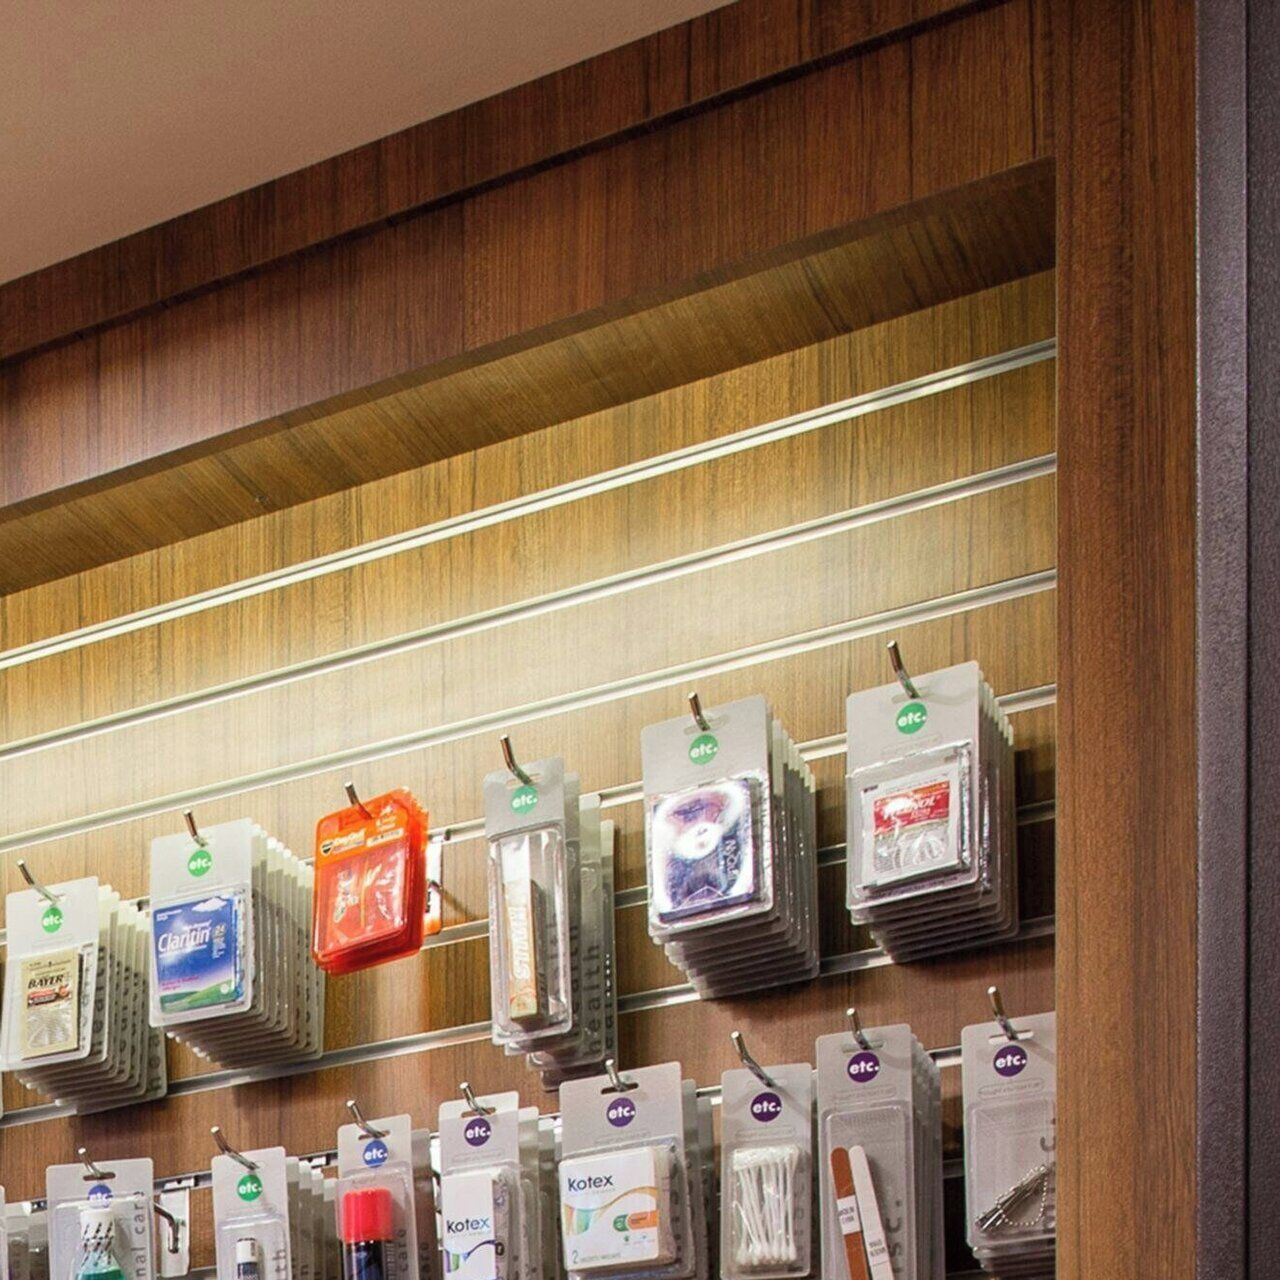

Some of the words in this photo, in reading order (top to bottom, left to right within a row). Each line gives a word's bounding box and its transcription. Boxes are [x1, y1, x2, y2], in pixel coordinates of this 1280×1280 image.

[898, 710, 927, 725] etc.
[690, 742, 718, 759] etc.
[511, 793, 537, 808] etc.
[190, 857, 213, 871] etc.
[42, 914, 63, 928] etc.
[157, 927, 211, 953] Claritin
[849, 1061, 880, 1074] etc.
[996, 1056, 1027, 1069] etc.
[608, 1106, 636, 1120] etc.
[753, 1100, 782, 1113] etc.
[465, 1126, 491, 1139] etc.
[363, 1148, 389, 1161] etc.
[238, 1181, 262, 1194] etc.
[568, 1175, 613, 1191] kotex
[90, 1190, 112, 1203] etc.
[447, 1217, 490, 1233] kotex
